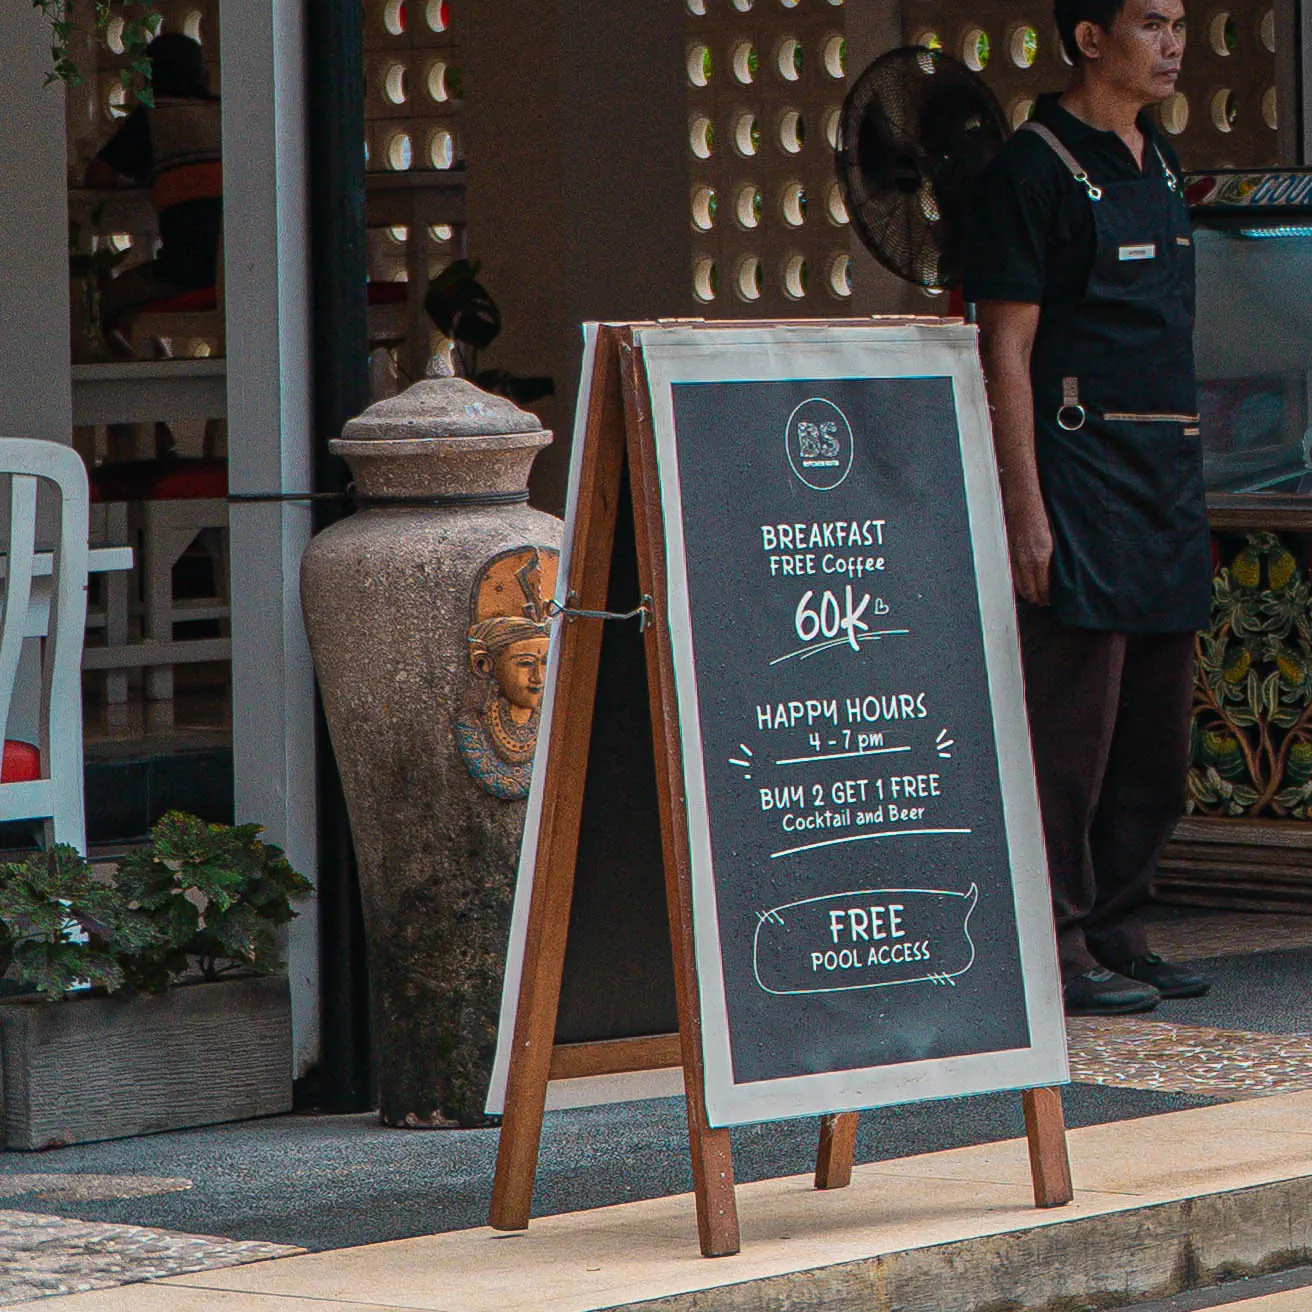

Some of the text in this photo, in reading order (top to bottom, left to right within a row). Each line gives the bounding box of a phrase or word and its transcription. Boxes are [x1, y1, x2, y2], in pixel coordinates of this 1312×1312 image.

[761, 520, 885, 550] BREAKFAST
[770, 554, 885, 578] FREE Coffee
[756, 693, 928, 730] HAPPY HOURS
[809, 732, 821, 751] 4
[842, 730, 851, 750] 7
[857, 732, 884, 753] pm
[759, 774, 941, 811] BUY 2 GET 1 FREE
[782, 804, 925, 831] Cocktail and Beer
[829, 904, 905, 944] FREE
[811, 941, 931, 972] POOL ACCESS
